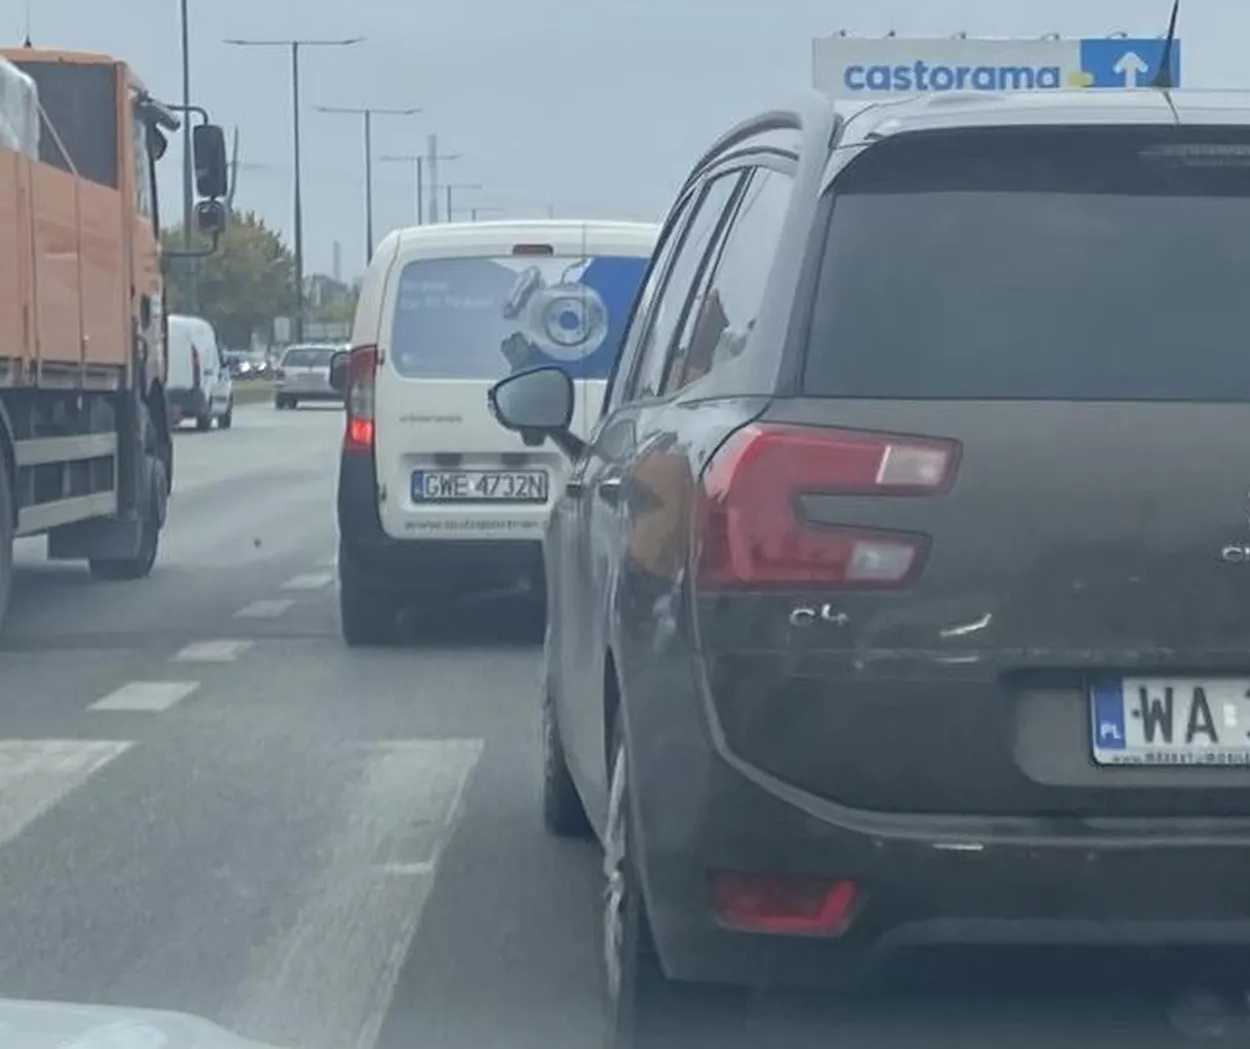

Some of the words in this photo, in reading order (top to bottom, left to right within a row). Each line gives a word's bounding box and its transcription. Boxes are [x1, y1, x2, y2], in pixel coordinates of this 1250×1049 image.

[843, 60, 1060, 92] castorama
[425, 474, 468, 497] GWE
[475, 474, 544, 497] 4732N
[1139, 686, 1218, 744] WA
[1100, 723, 1122, 740] PL
